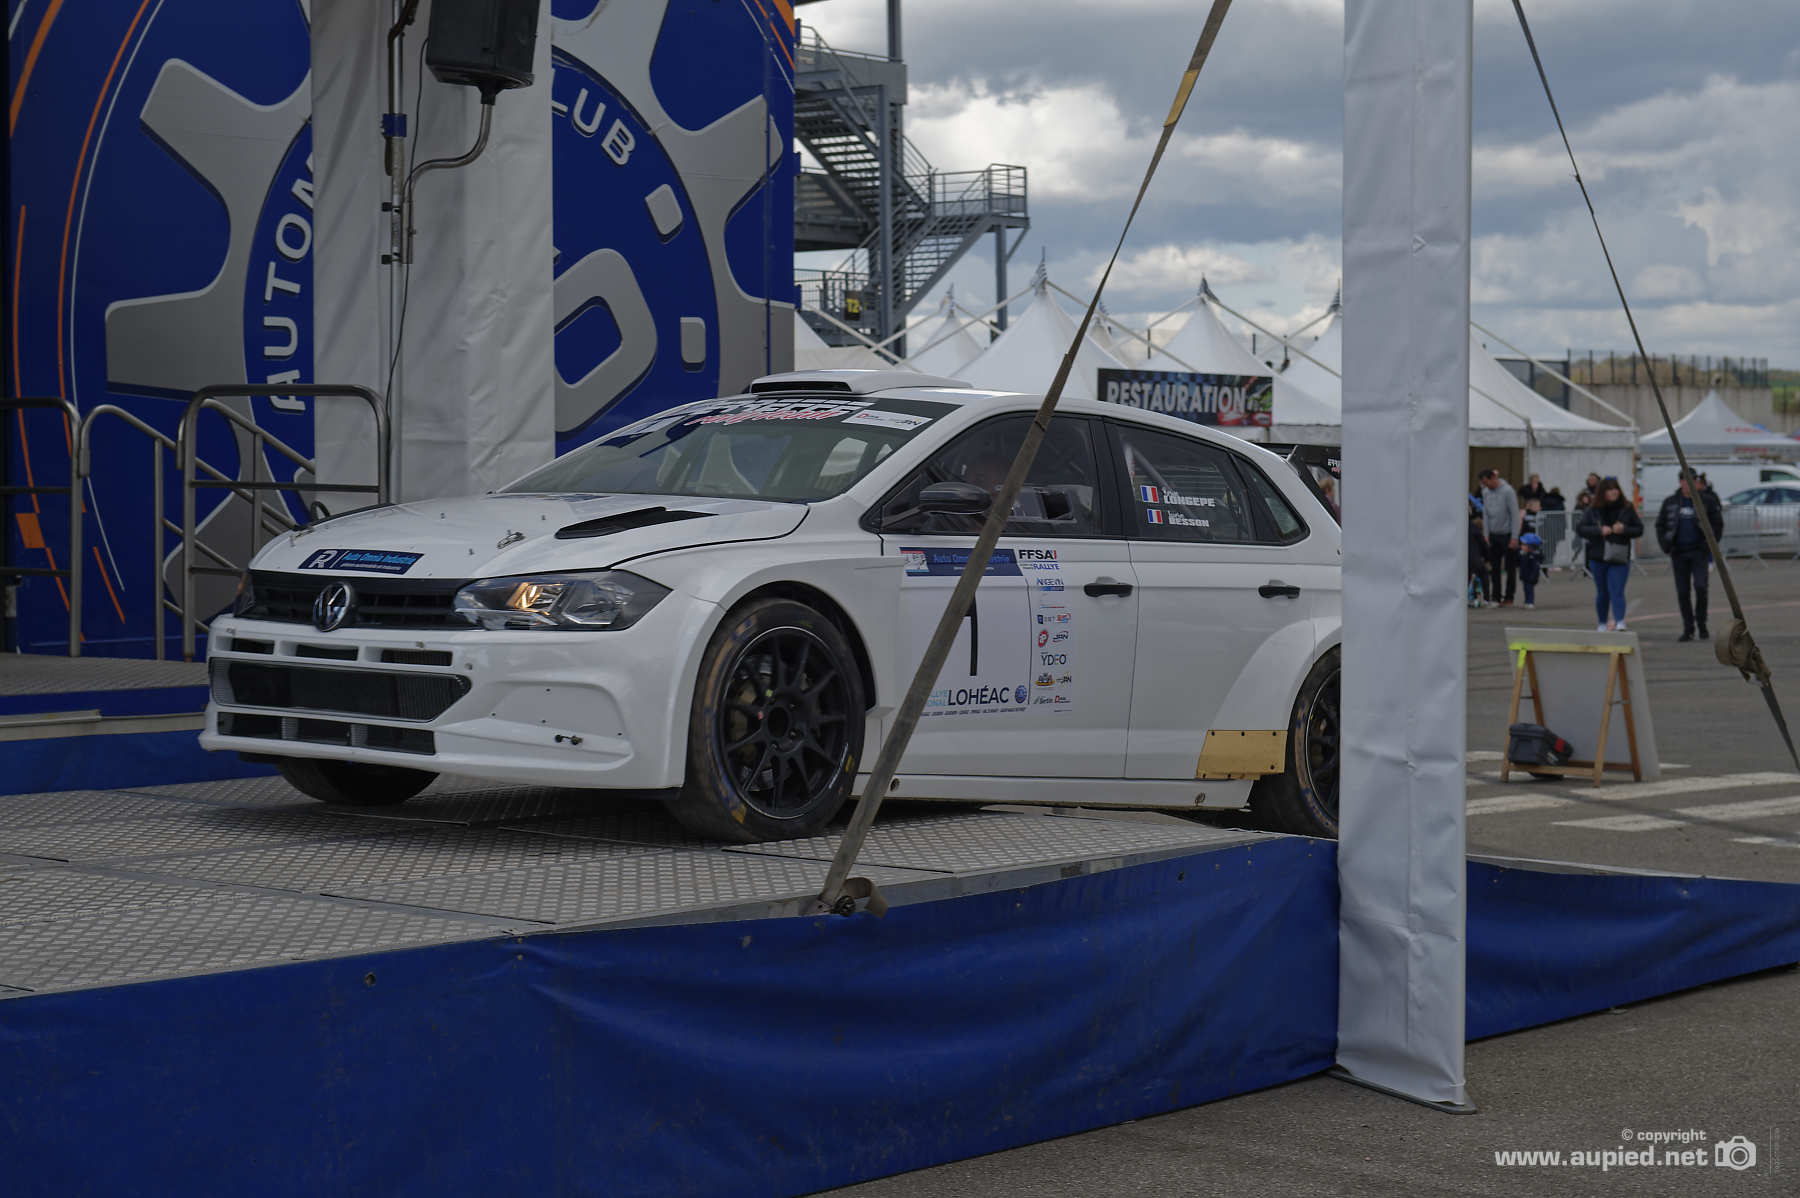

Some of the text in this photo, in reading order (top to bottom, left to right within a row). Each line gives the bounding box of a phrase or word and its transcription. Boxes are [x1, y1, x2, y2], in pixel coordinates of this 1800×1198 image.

[1106, 380, 1247, 415] RESTAURATION
[1019, 549, 1054, 560] FFSA
[947, 685, 1010, 706] LOHÉAC
